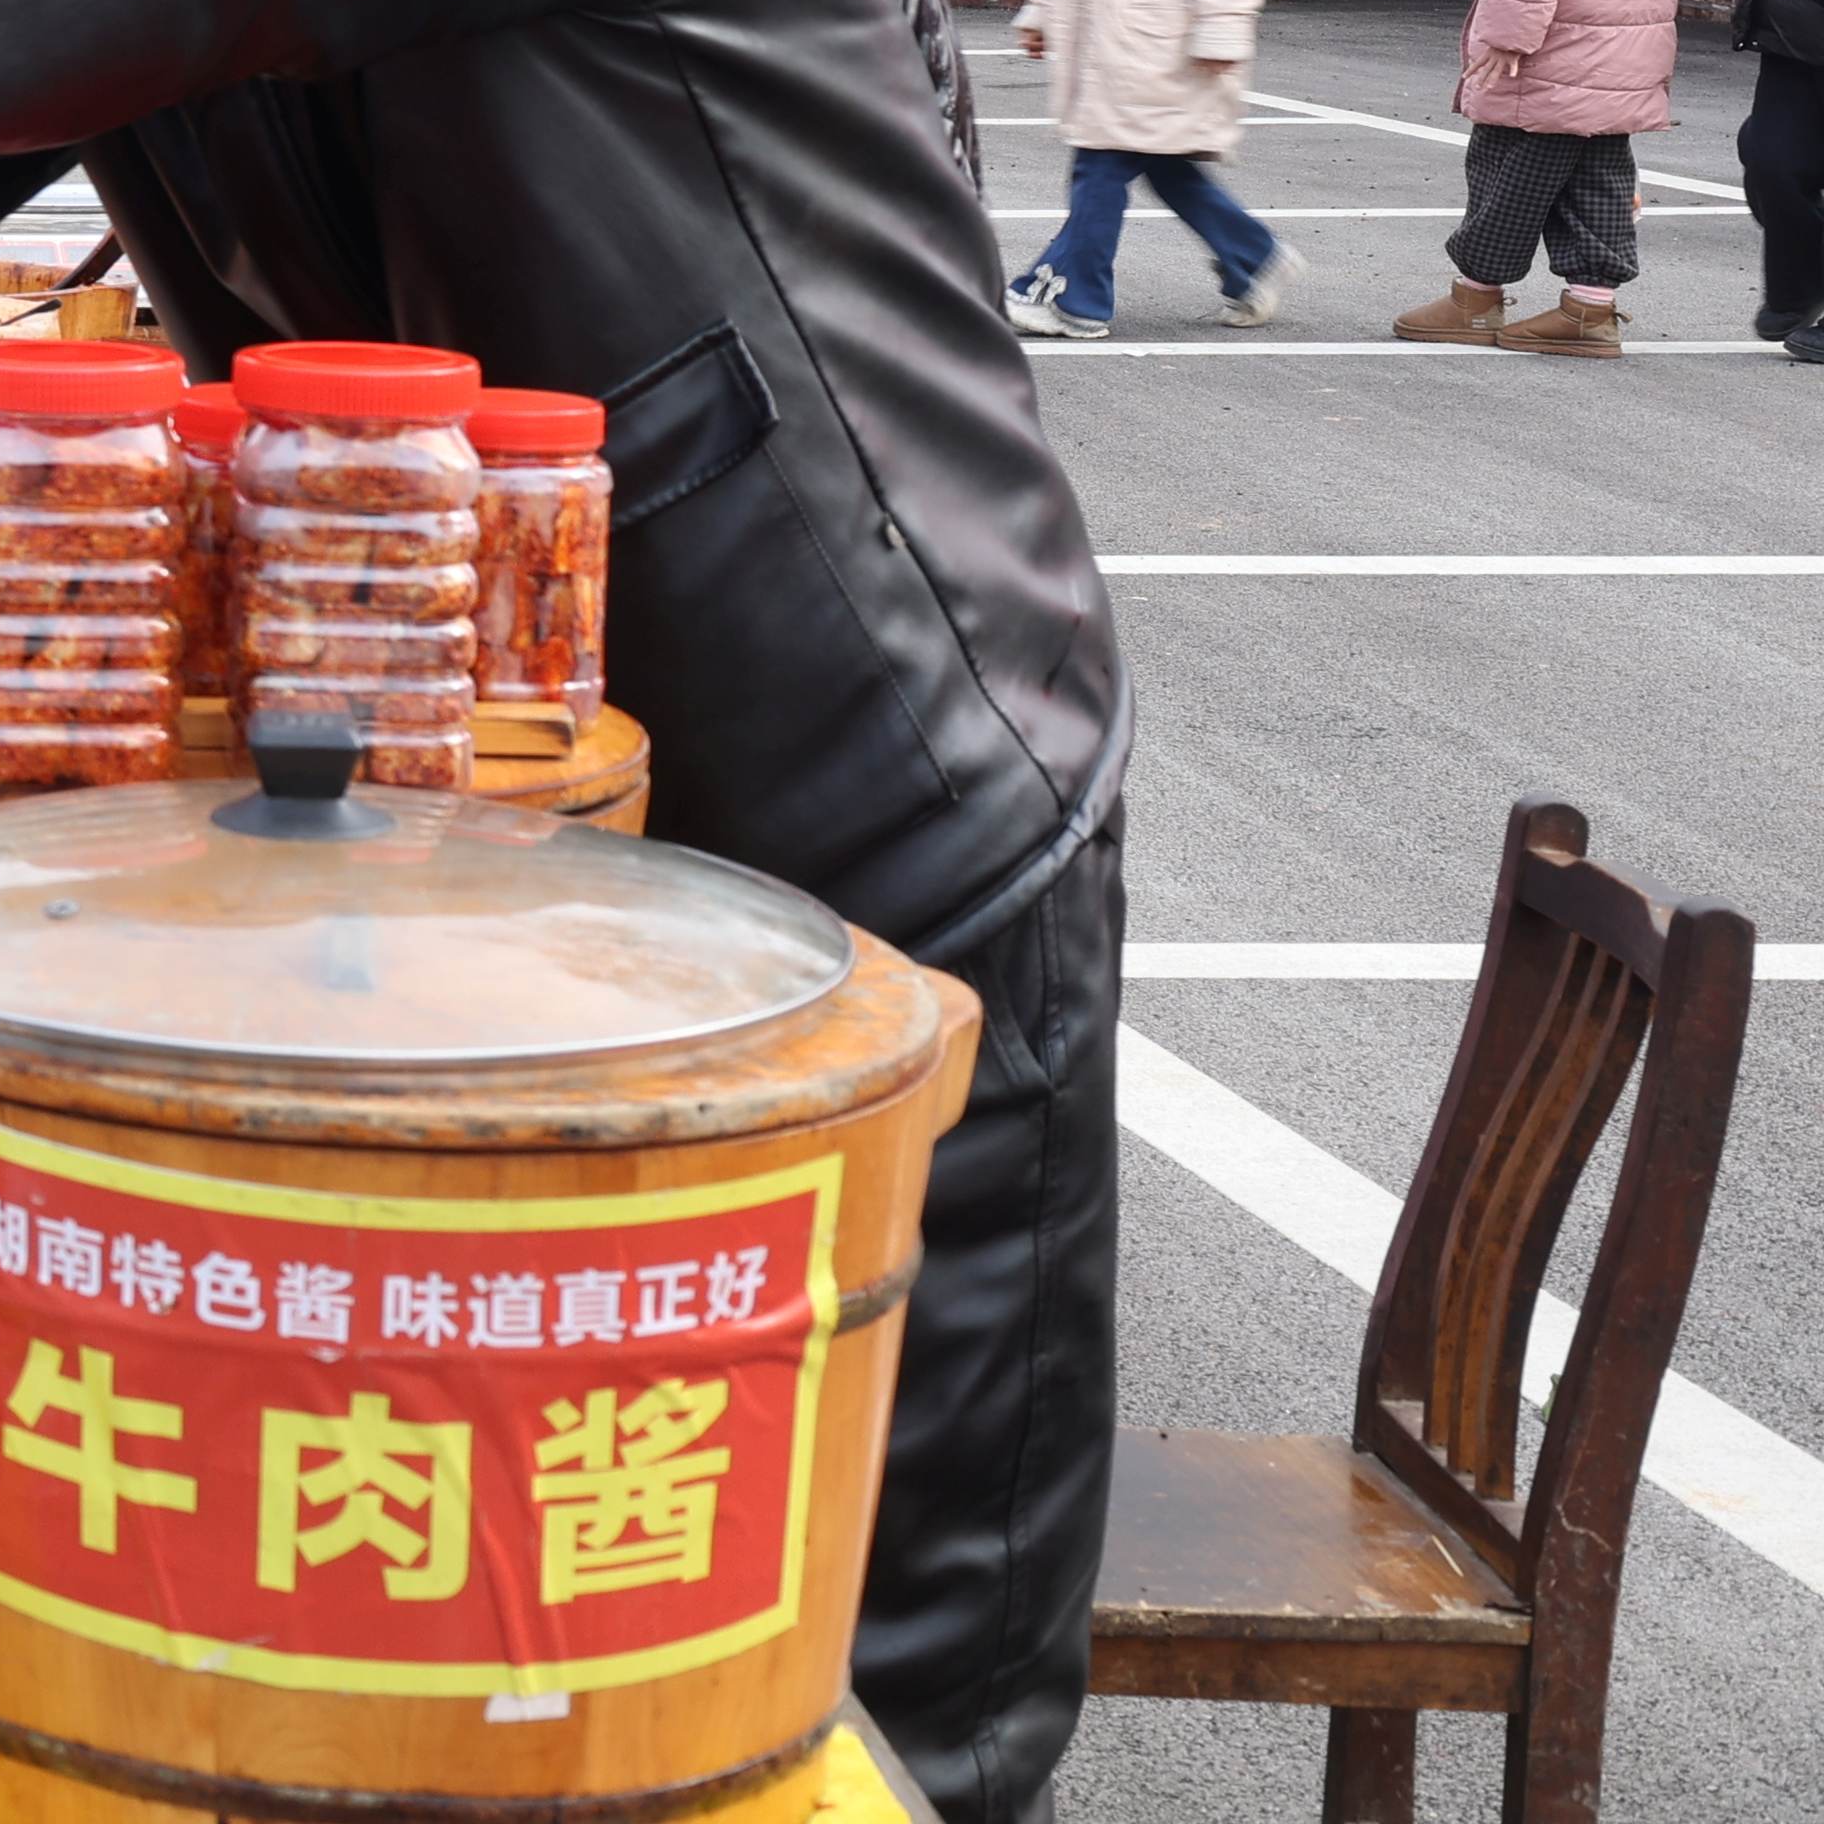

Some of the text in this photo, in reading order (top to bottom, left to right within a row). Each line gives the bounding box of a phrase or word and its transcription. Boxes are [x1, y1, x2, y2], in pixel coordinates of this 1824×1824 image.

[380, 1245, 770, 1351] 味道真正好
[1, 1336, 732, 1606] 牛肉酱
